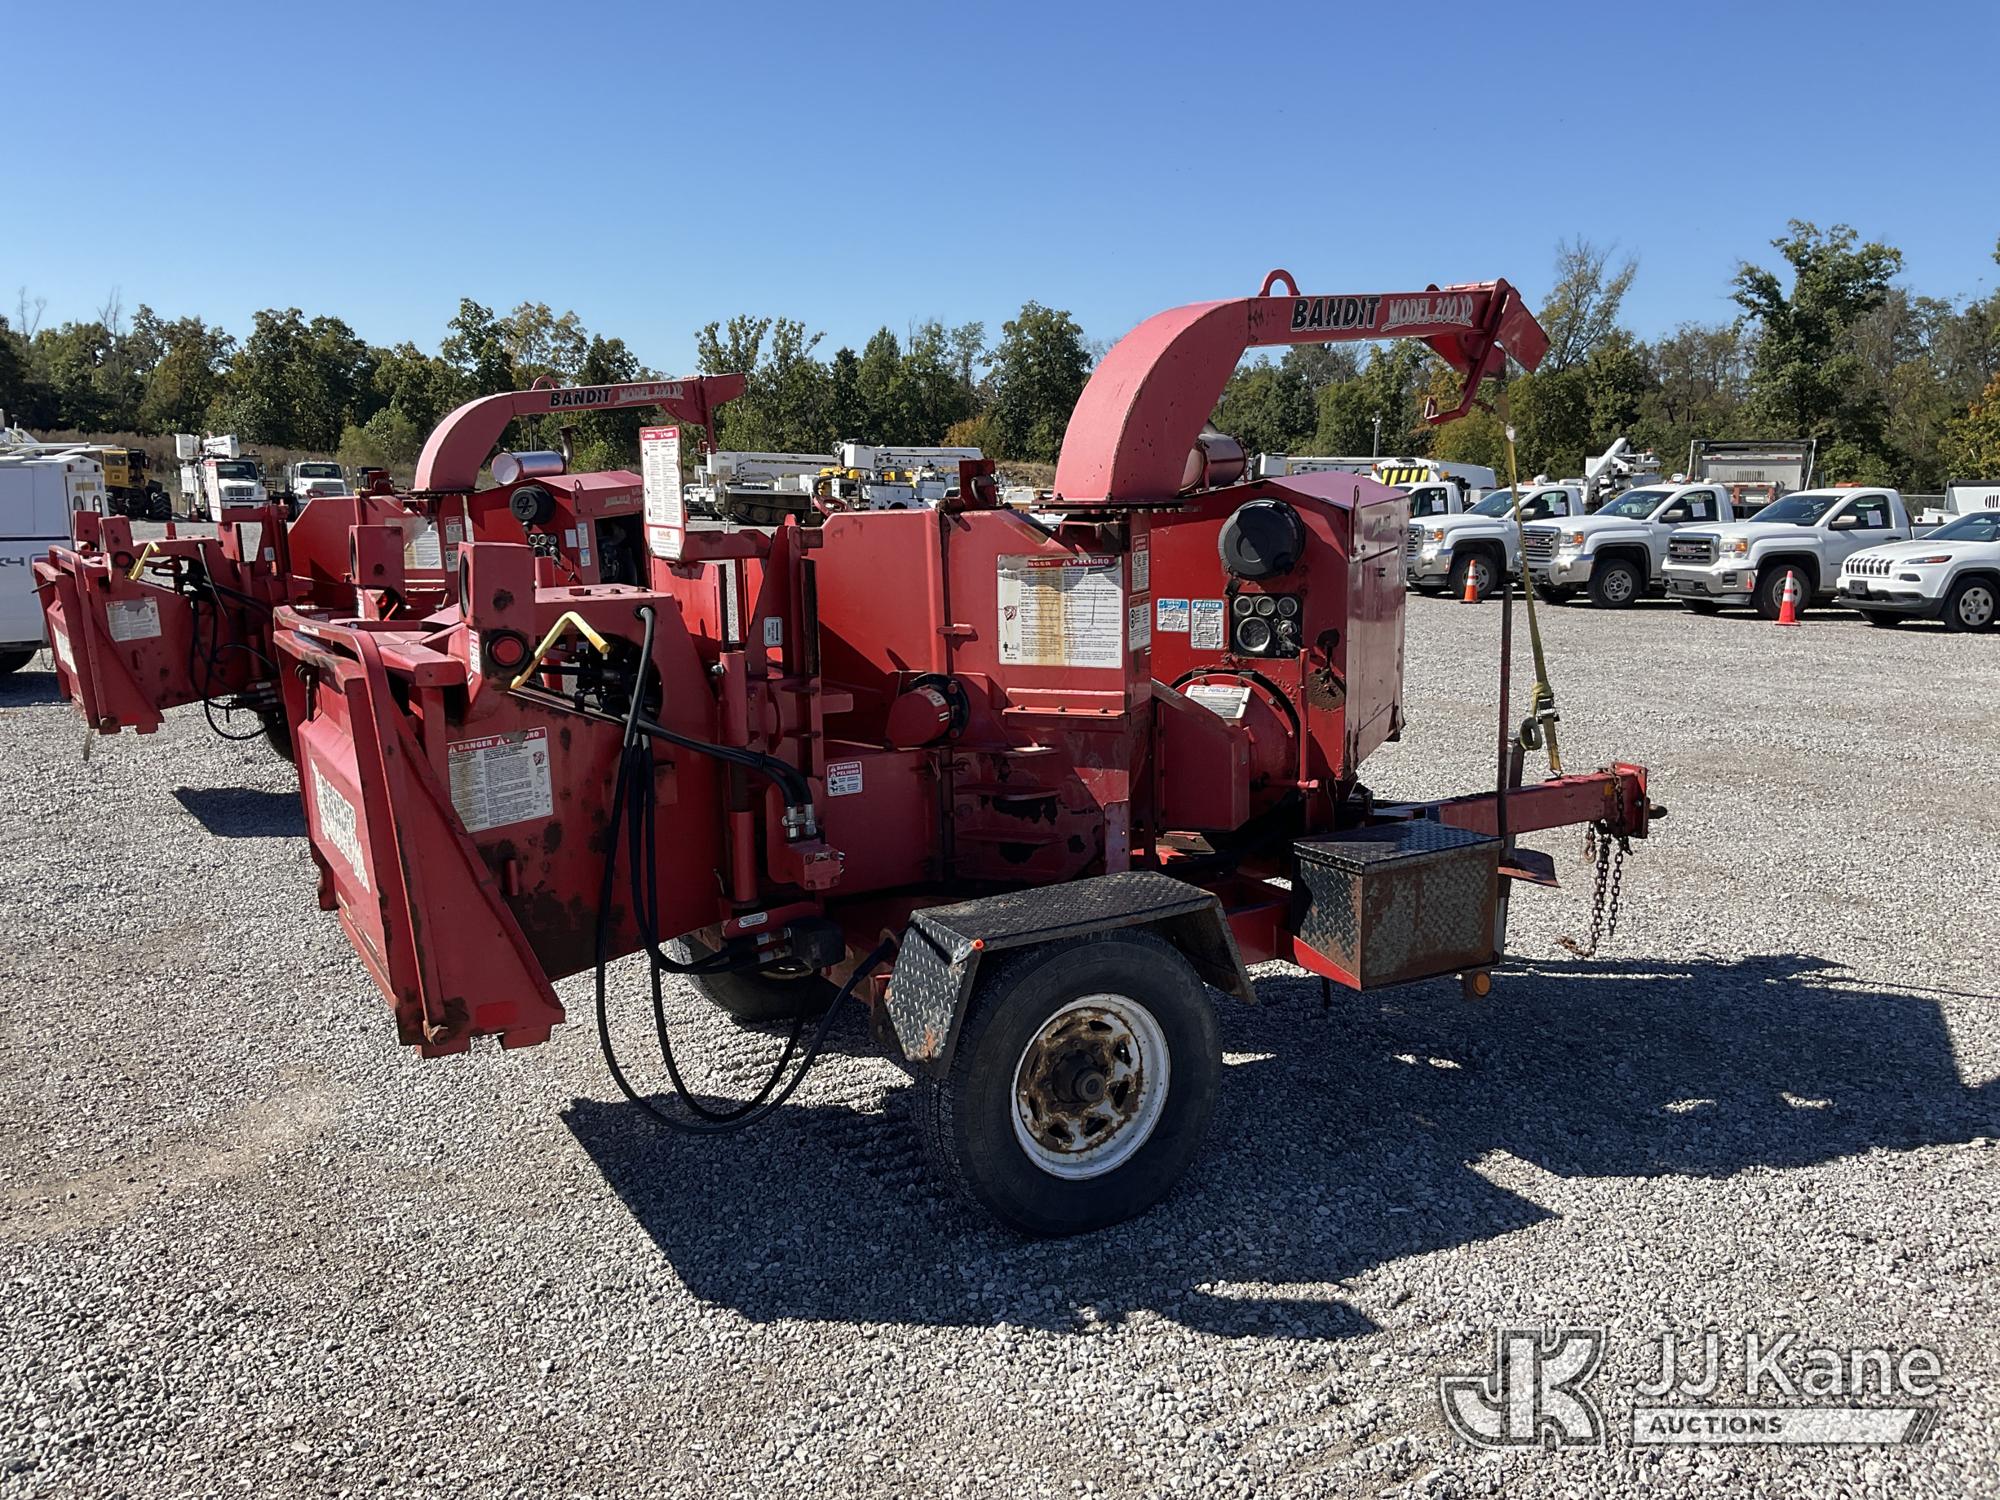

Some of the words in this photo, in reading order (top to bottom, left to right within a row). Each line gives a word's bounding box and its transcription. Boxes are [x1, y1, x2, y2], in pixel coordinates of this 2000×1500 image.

[1291, 296, 1381, 331] BANDIT
[1388, 298, 1430, 325] MODEL
[1433, 296, 1458, 322] 200
[550, 389, 611, 407] BANDIT
[458, 739, 493, 751] DANGER
